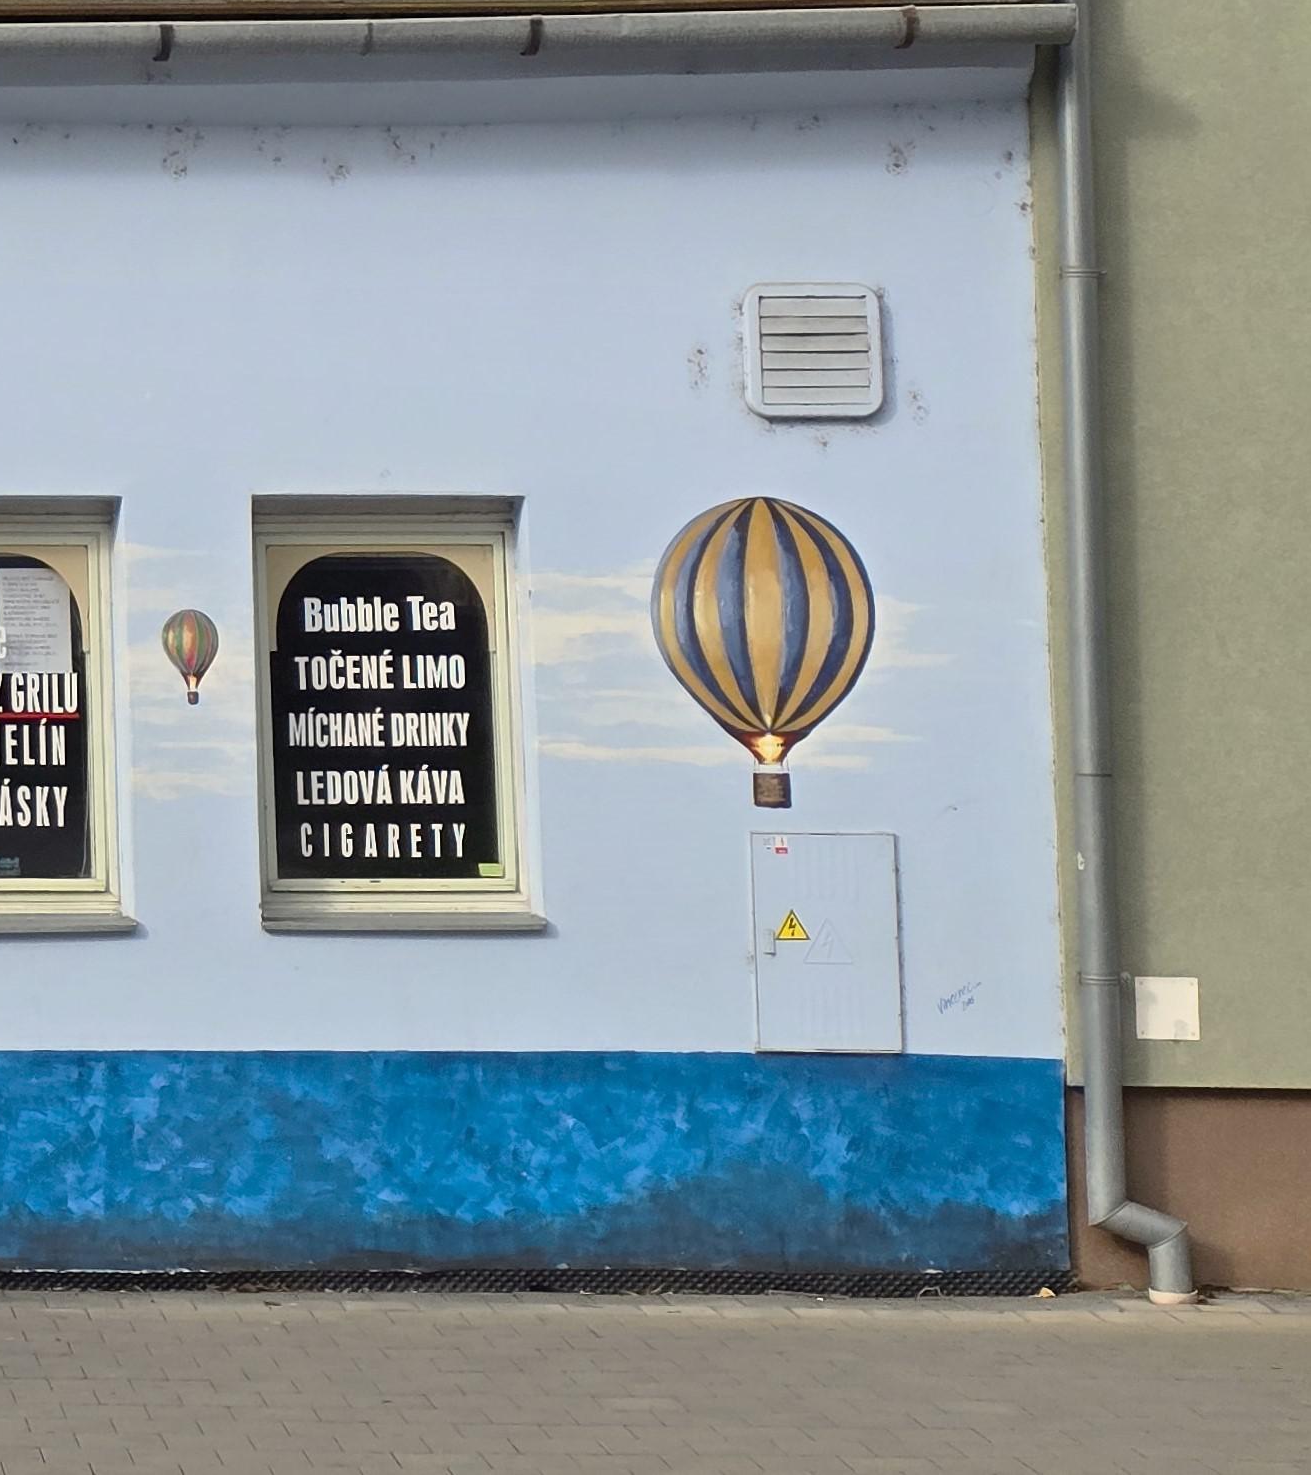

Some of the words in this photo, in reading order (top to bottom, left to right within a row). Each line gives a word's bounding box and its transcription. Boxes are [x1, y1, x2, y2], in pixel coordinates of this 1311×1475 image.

[303, 596, 400, 633] Bubble
[407, 595, 456, 631] Tea
[294, 649, 395, 691] TOČENÉ
[402, 654, 466, 690] LIMO
[11, 672, 78, 713] GRILU
[288, 707, 385, 748] MÍCHANÉ
[392, 712, 470, 748] DRINKY
[296, 764, 393, 805] LEDOVÁ
[400, 764, 465, 805] KÁVA
[300, 822, 467, 858] CIGARETY
